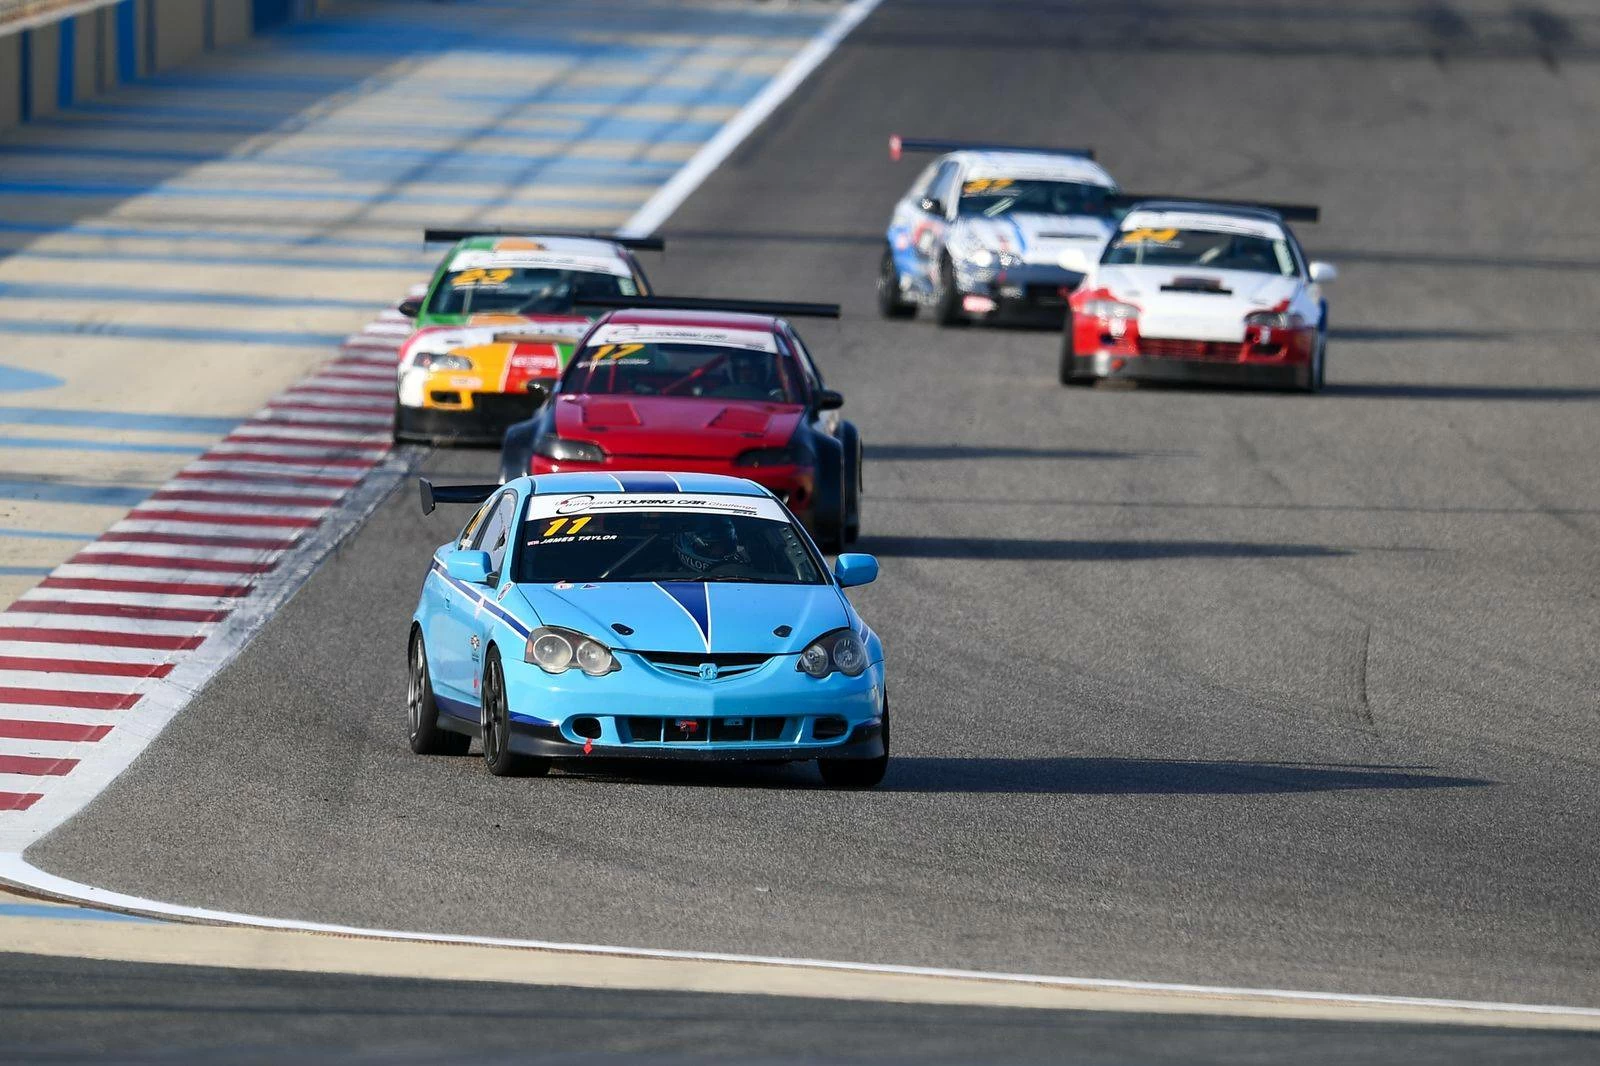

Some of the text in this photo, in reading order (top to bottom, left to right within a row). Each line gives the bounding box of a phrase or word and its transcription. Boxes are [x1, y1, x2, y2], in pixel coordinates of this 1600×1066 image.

[592, 343, 645, 361] 17
[708, 501, 758, 510] Challenge
[543, 516, 592, 537] 11
[540, 536, 575, 545] JAMES
